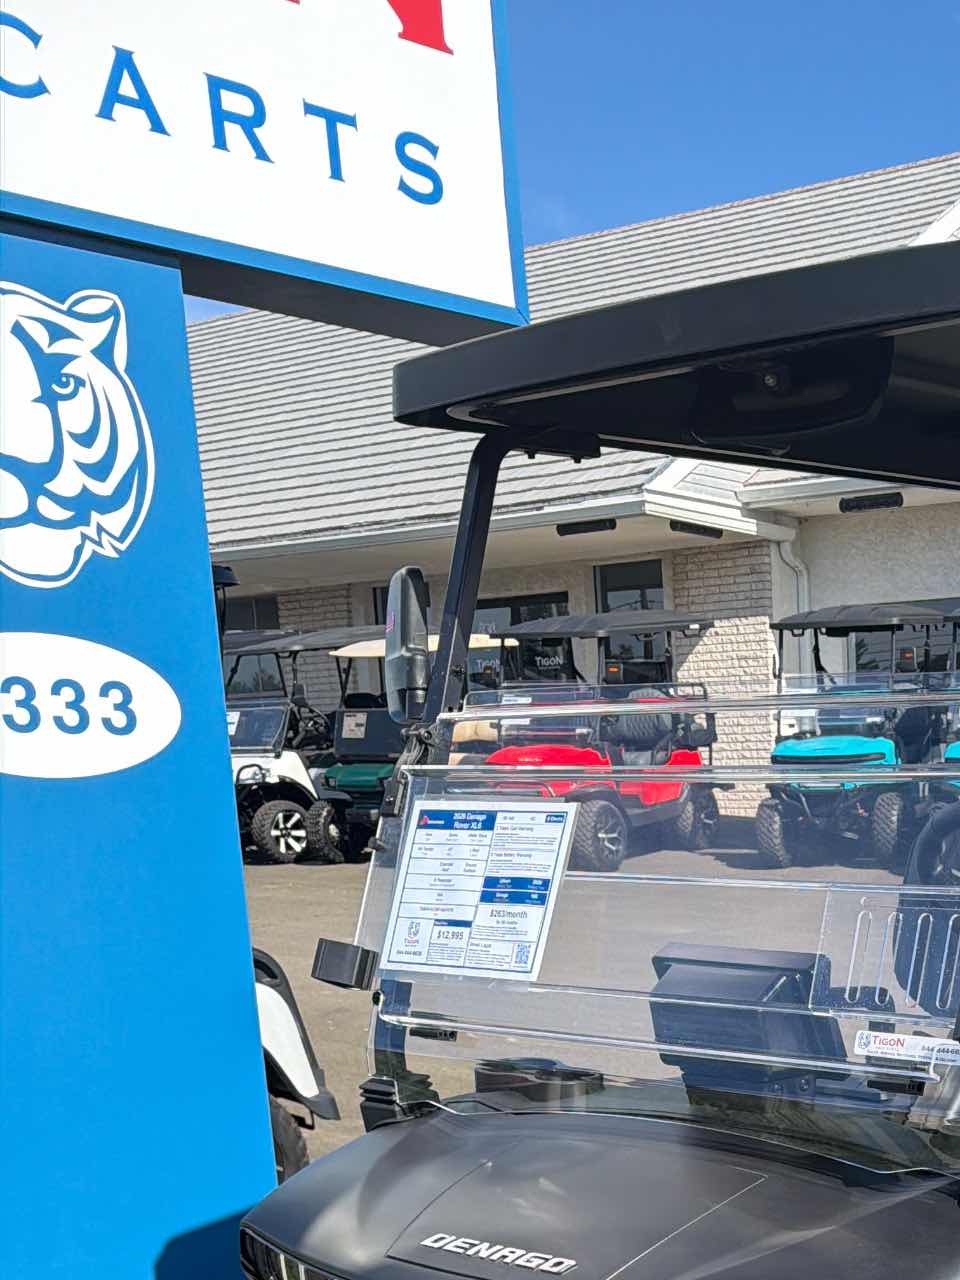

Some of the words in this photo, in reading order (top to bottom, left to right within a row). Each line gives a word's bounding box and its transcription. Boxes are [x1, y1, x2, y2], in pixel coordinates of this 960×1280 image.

[534, 655, 564, 667] TIGON
[0, 675, 138, 736] 333
[872, 1035, 905, 1048] TIGON
[420, 1233, 577, 1275] DENAGO
